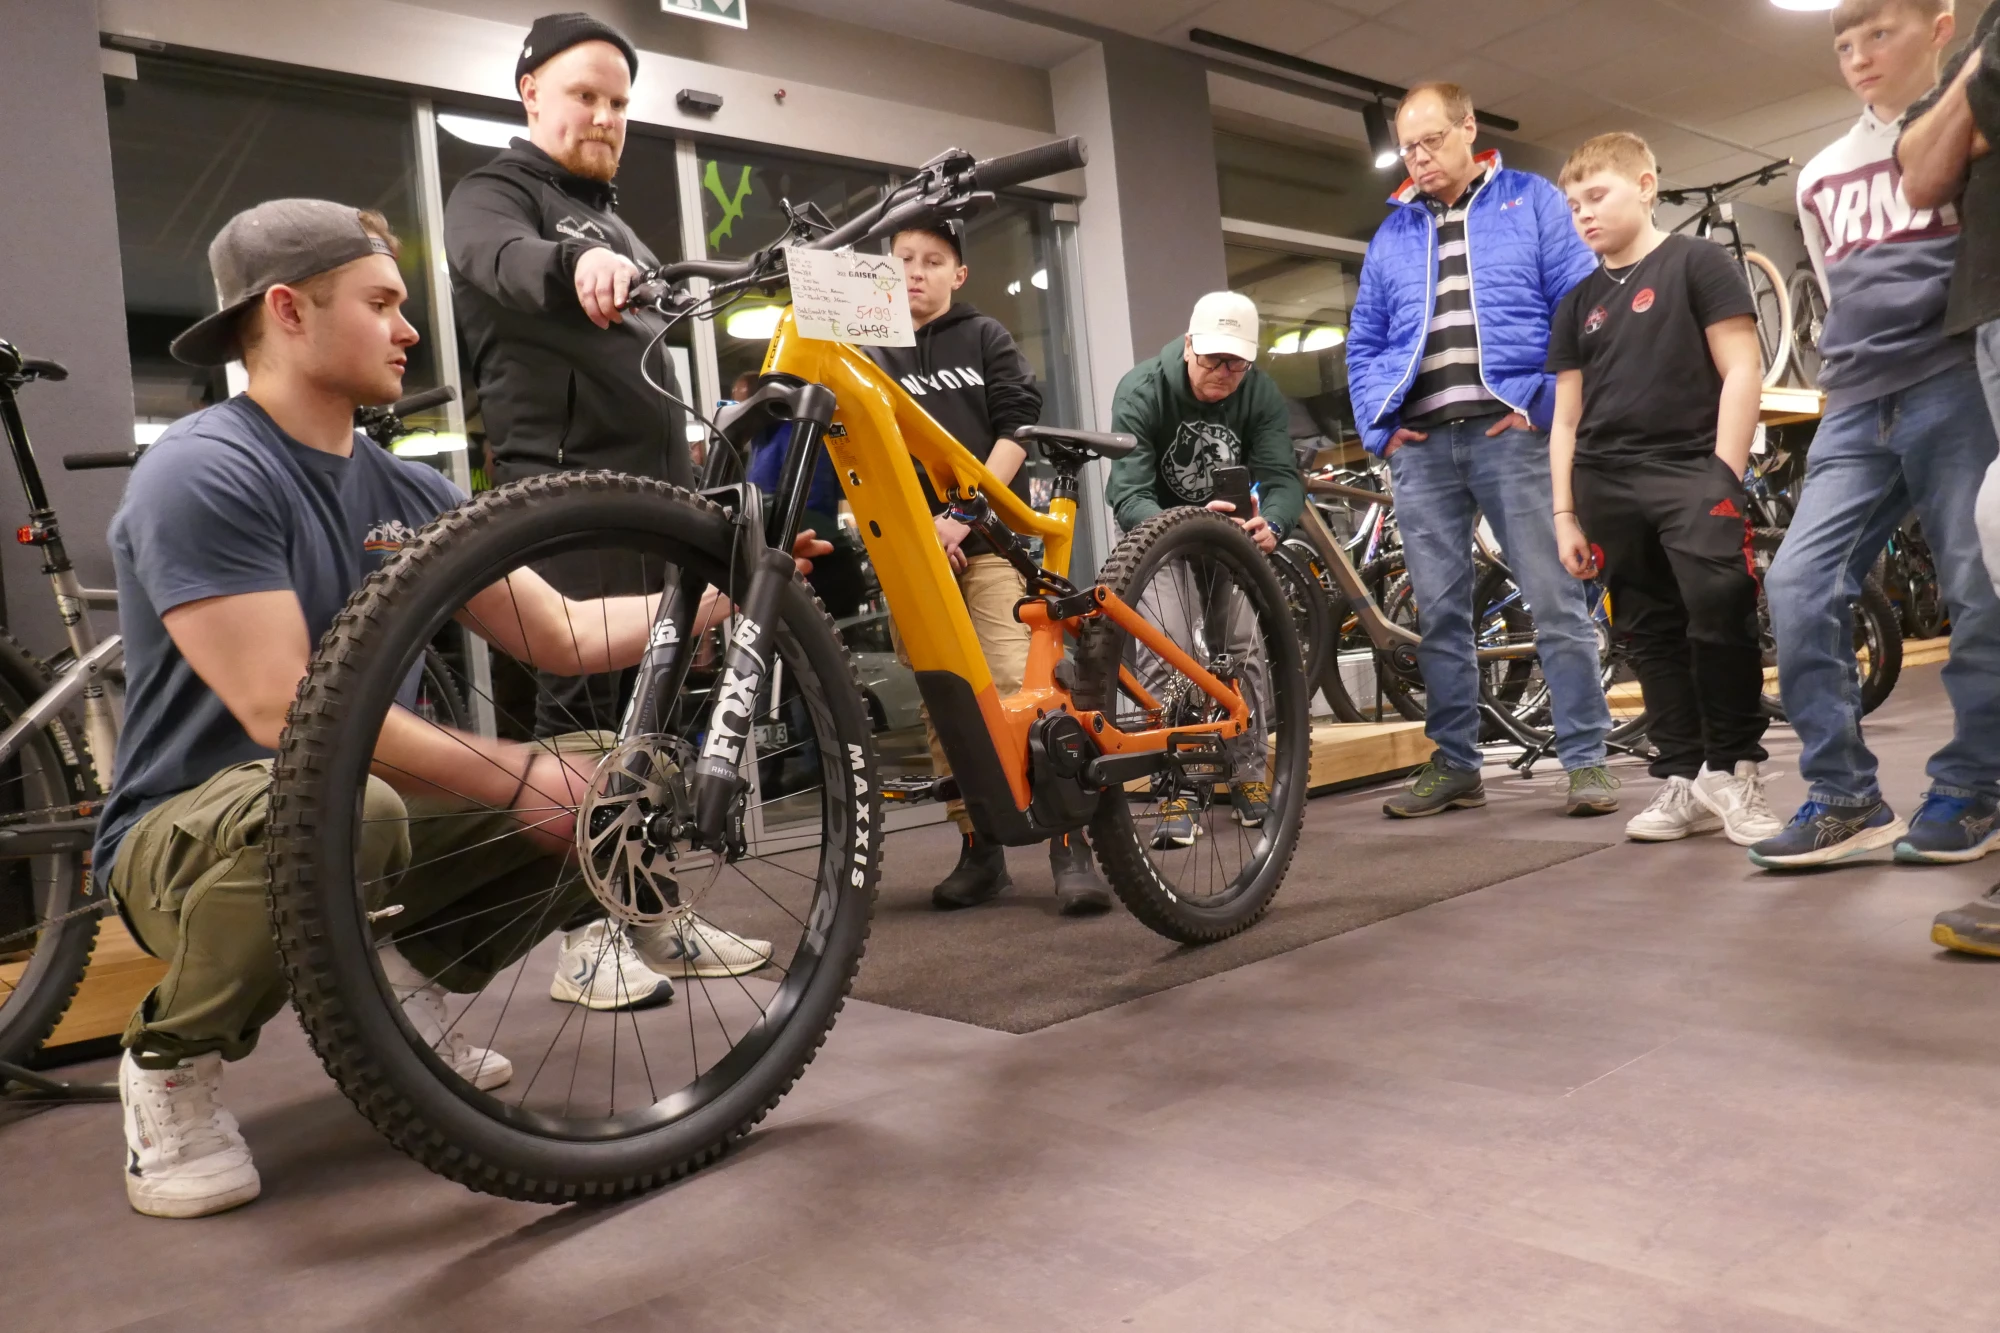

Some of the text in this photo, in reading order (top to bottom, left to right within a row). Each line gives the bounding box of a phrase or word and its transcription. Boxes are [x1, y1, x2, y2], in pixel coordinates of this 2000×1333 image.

[848, 270, 878, 280] GAISER
[703, 667, 759, 765] FOX
[774, 614, 847, 957] RACEFAC
[847, 743, 869, 889] MAXXIS
